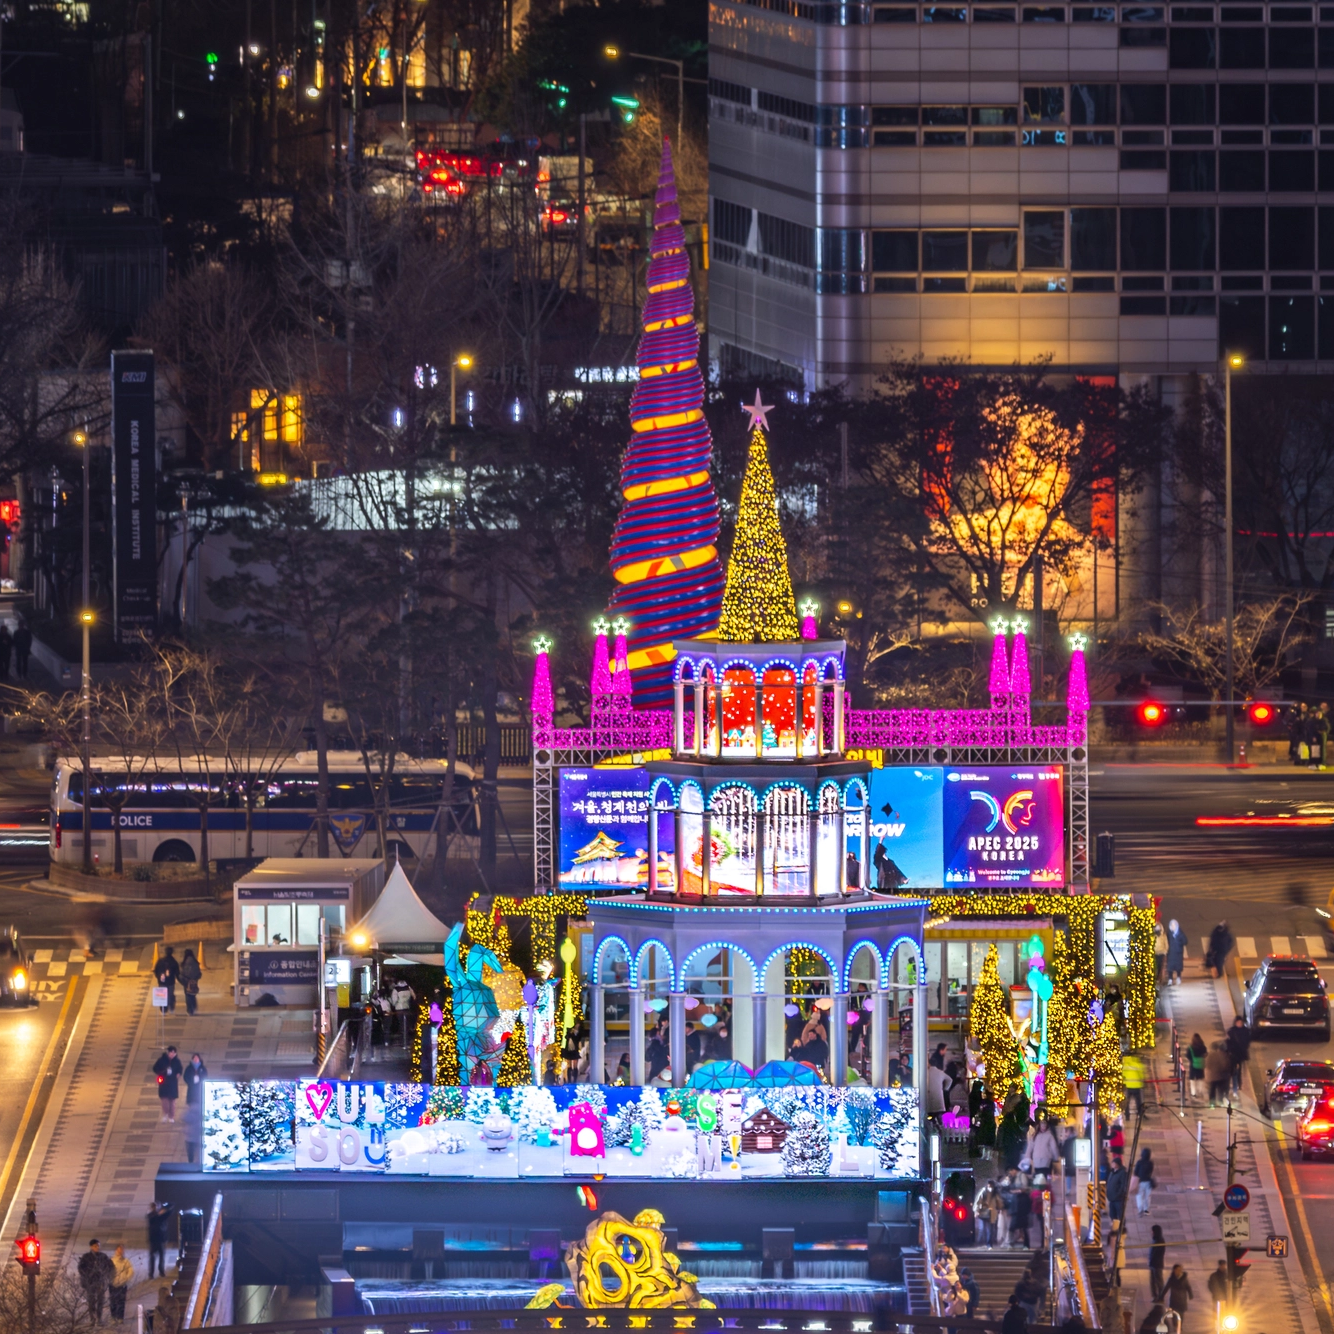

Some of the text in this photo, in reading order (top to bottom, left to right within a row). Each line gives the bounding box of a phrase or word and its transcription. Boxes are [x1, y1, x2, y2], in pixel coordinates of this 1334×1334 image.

[130, 419, 141, 560] KOREA MEDICAL INSTITUTE
[110, 814, 153, 827] POLICE
[968, 836, 1039, 851] APEC 2025
[981, 850, 1025, 861] KOREA
